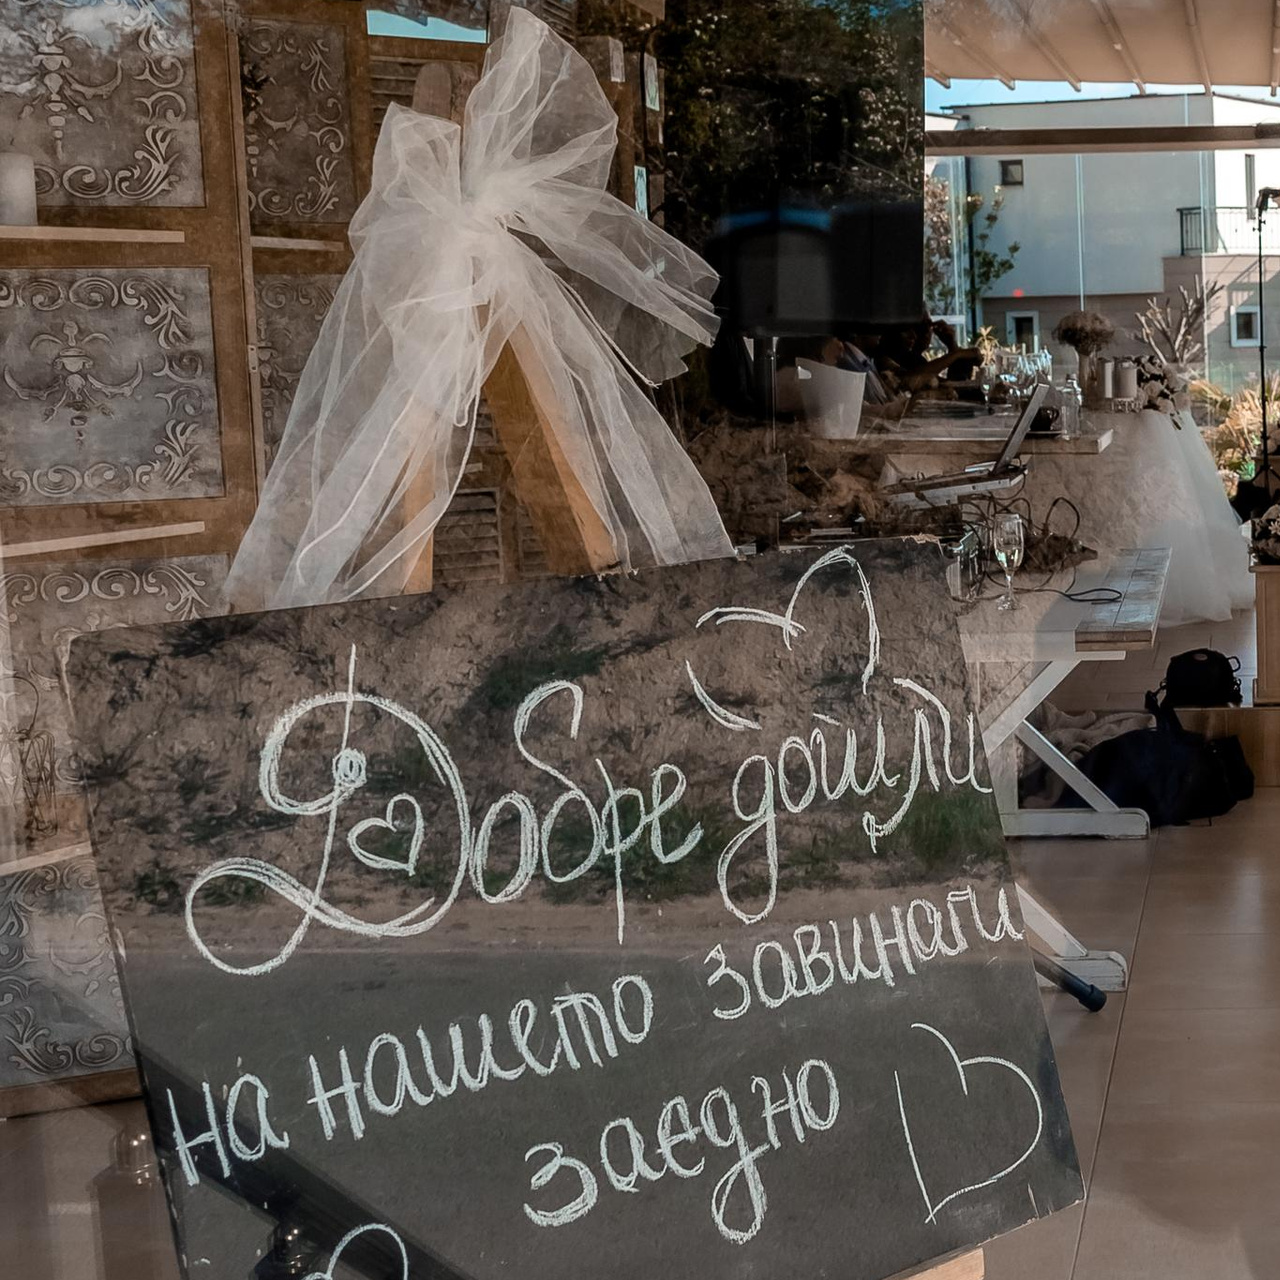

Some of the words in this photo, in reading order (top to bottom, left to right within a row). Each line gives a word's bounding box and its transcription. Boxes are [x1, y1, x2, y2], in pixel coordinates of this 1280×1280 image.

[184, 643, 704, 977] Добре
[717, 677, 994, 925] дошли
[306, 974, 655, 1141] нашето
[703, 883, 1025, 1020] завинаги
[523, 1058, 841, 1246] заедно
